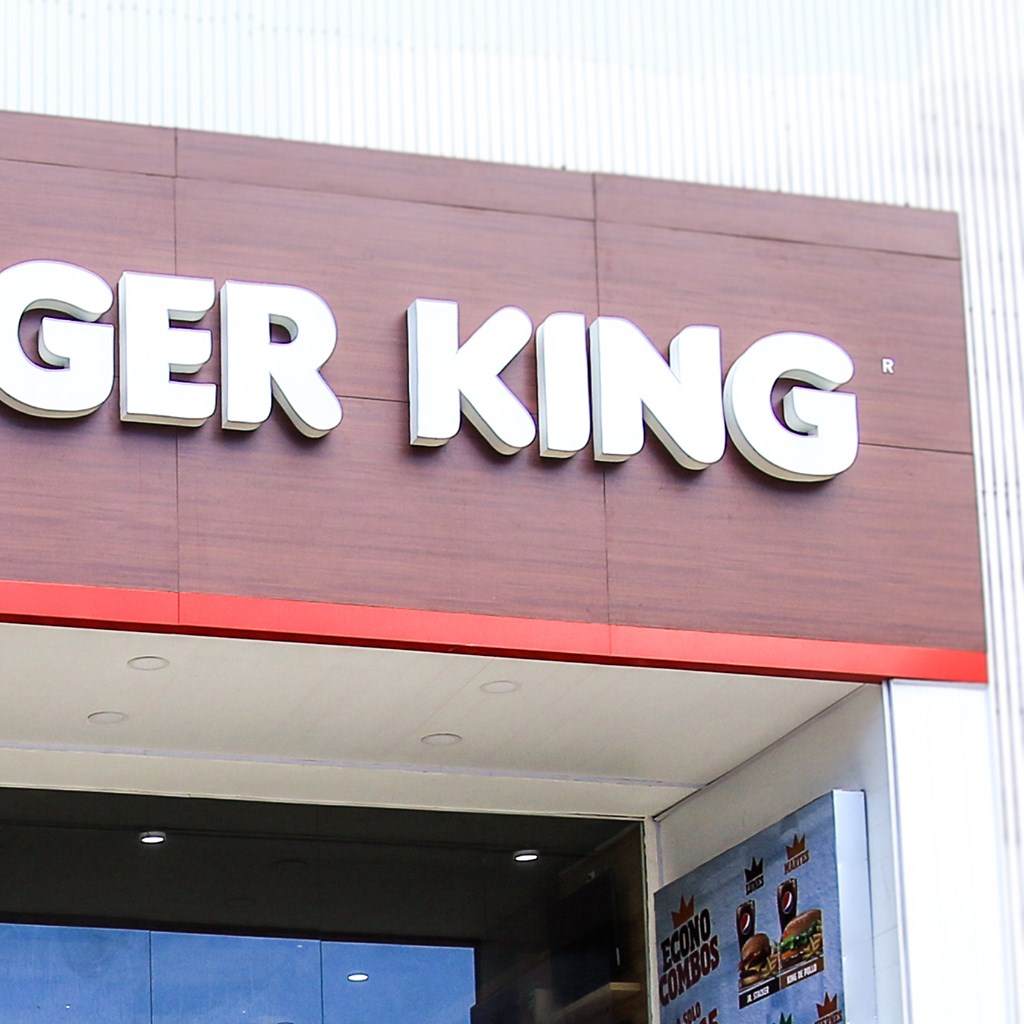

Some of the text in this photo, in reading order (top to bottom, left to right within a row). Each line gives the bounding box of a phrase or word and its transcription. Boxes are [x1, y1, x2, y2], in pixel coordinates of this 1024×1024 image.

[407, 297, 860, 483] KING
[659, 934, 721, 1007] COMBOS
[660, 908, 712, 973] ECONO
